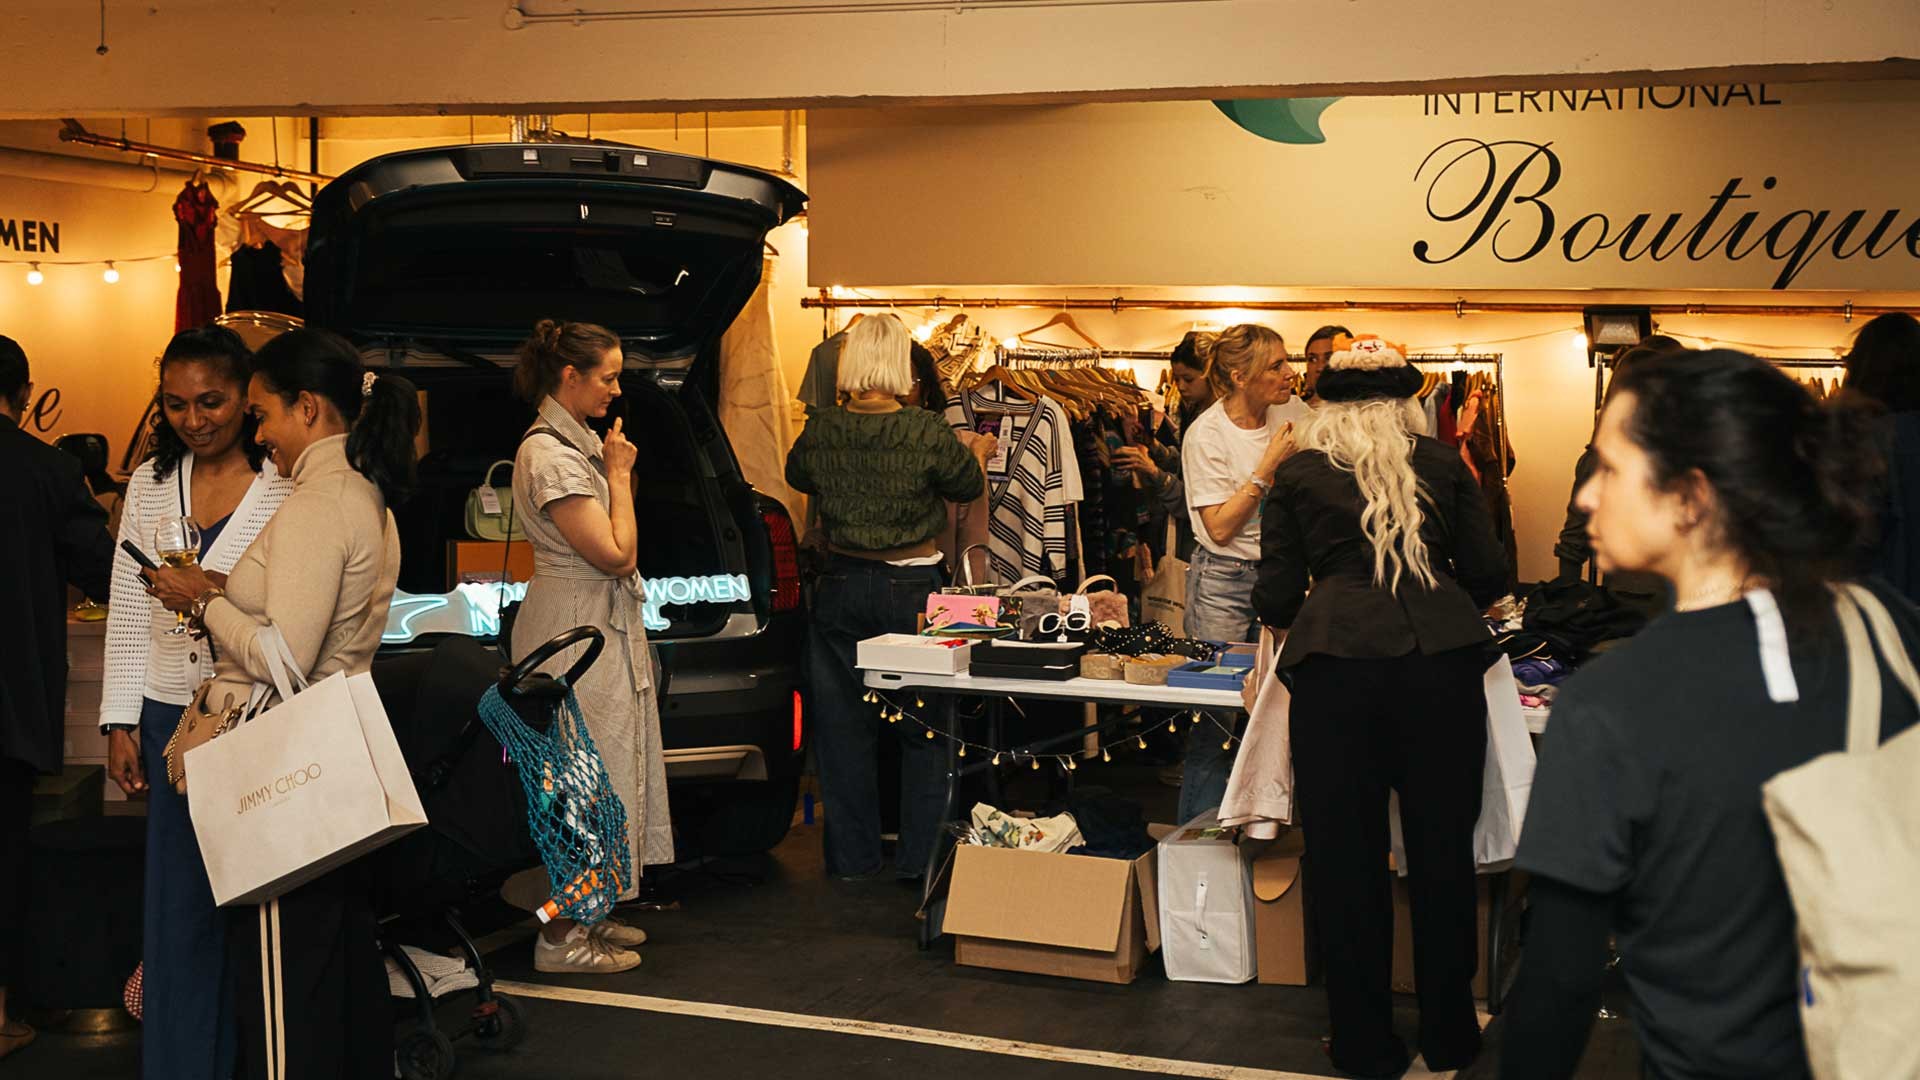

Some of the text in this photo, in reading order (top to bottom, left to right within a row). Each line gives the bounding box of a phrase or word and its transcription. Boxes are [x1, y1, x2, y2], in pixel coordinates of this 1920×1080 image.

[1424, 83, 1782, 116] INTERNATIONAL
[0, 218, 60, 254] MEN
[641, 575, 749, 602] WOMEN
[237, 763, 322, 815] JIMMY CHOO
